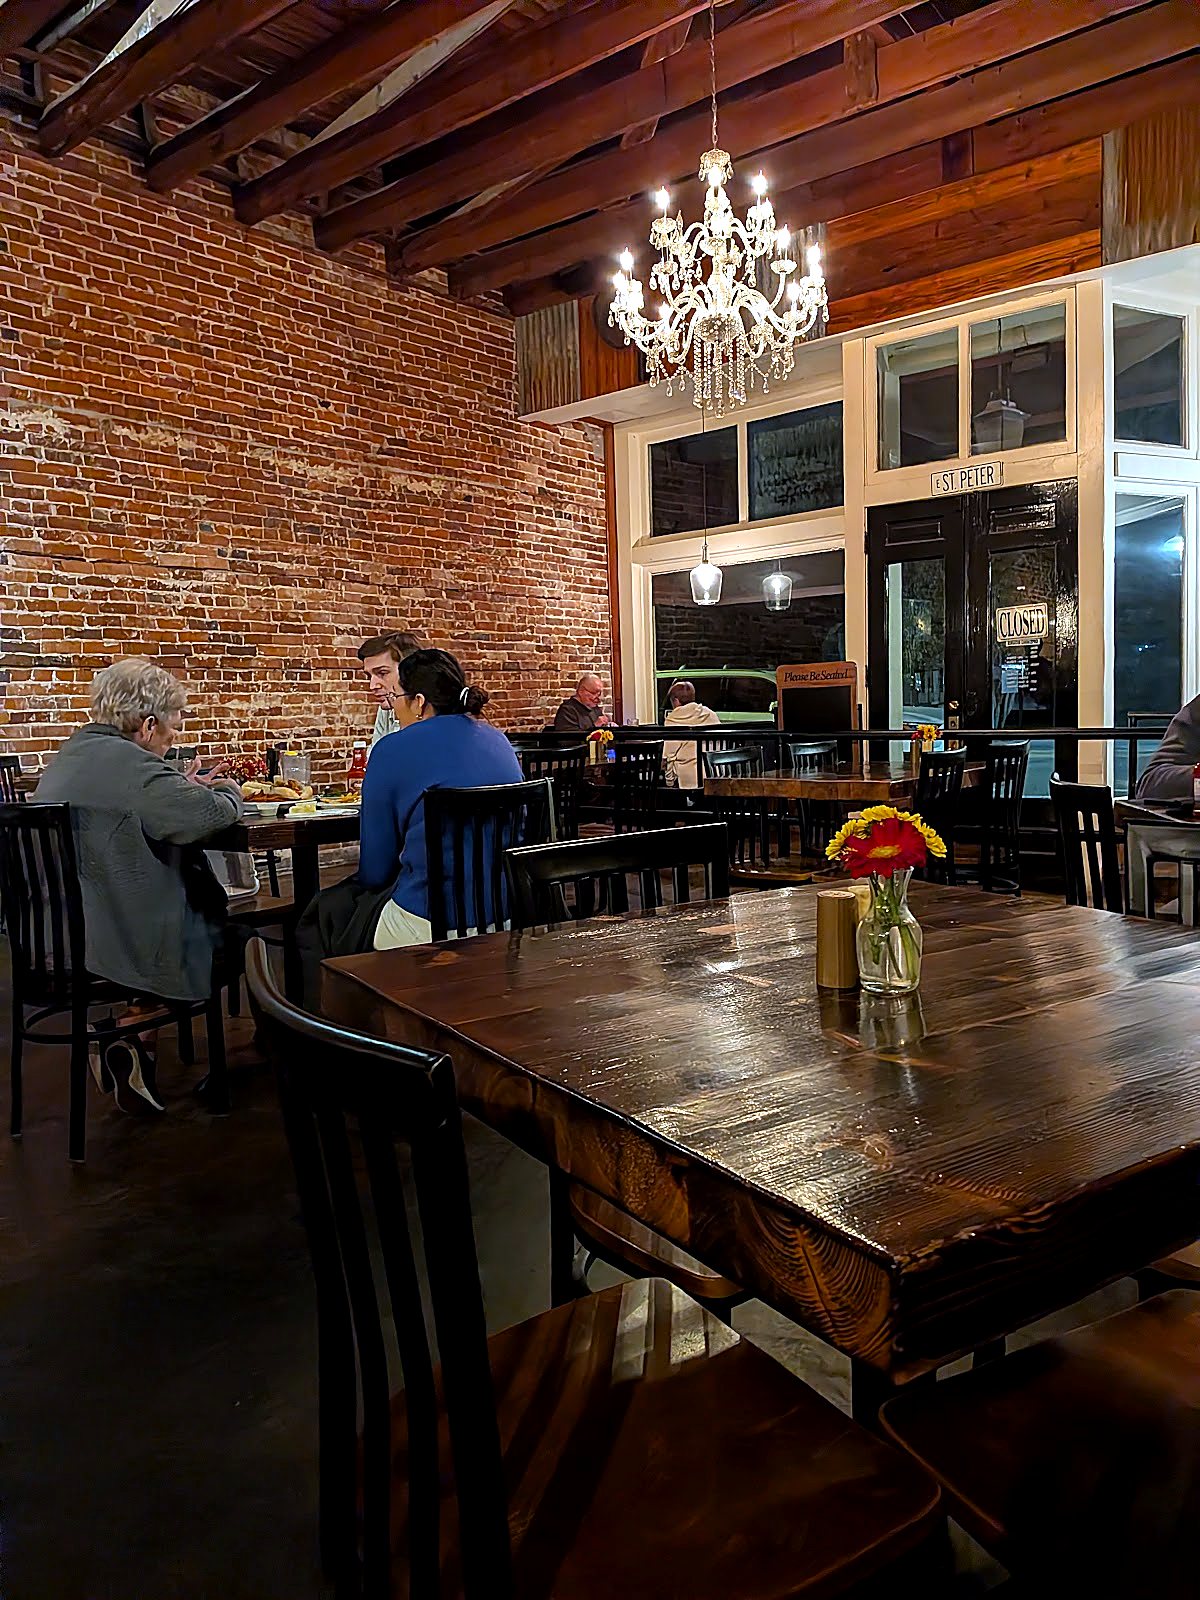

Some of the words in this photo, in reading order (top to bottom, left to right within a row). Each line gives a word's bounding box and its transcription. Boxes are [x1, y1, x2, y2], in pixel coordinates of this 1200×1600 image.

[936, 479, 941, 489] E
[942, 472, 957, 492] ST.
[960, 465, 994, 489] PETER
[1000, 608, 1045, 638] CLOSED
[784, 672, 809, 682] Please
[809, 671, 820, 681] Be
